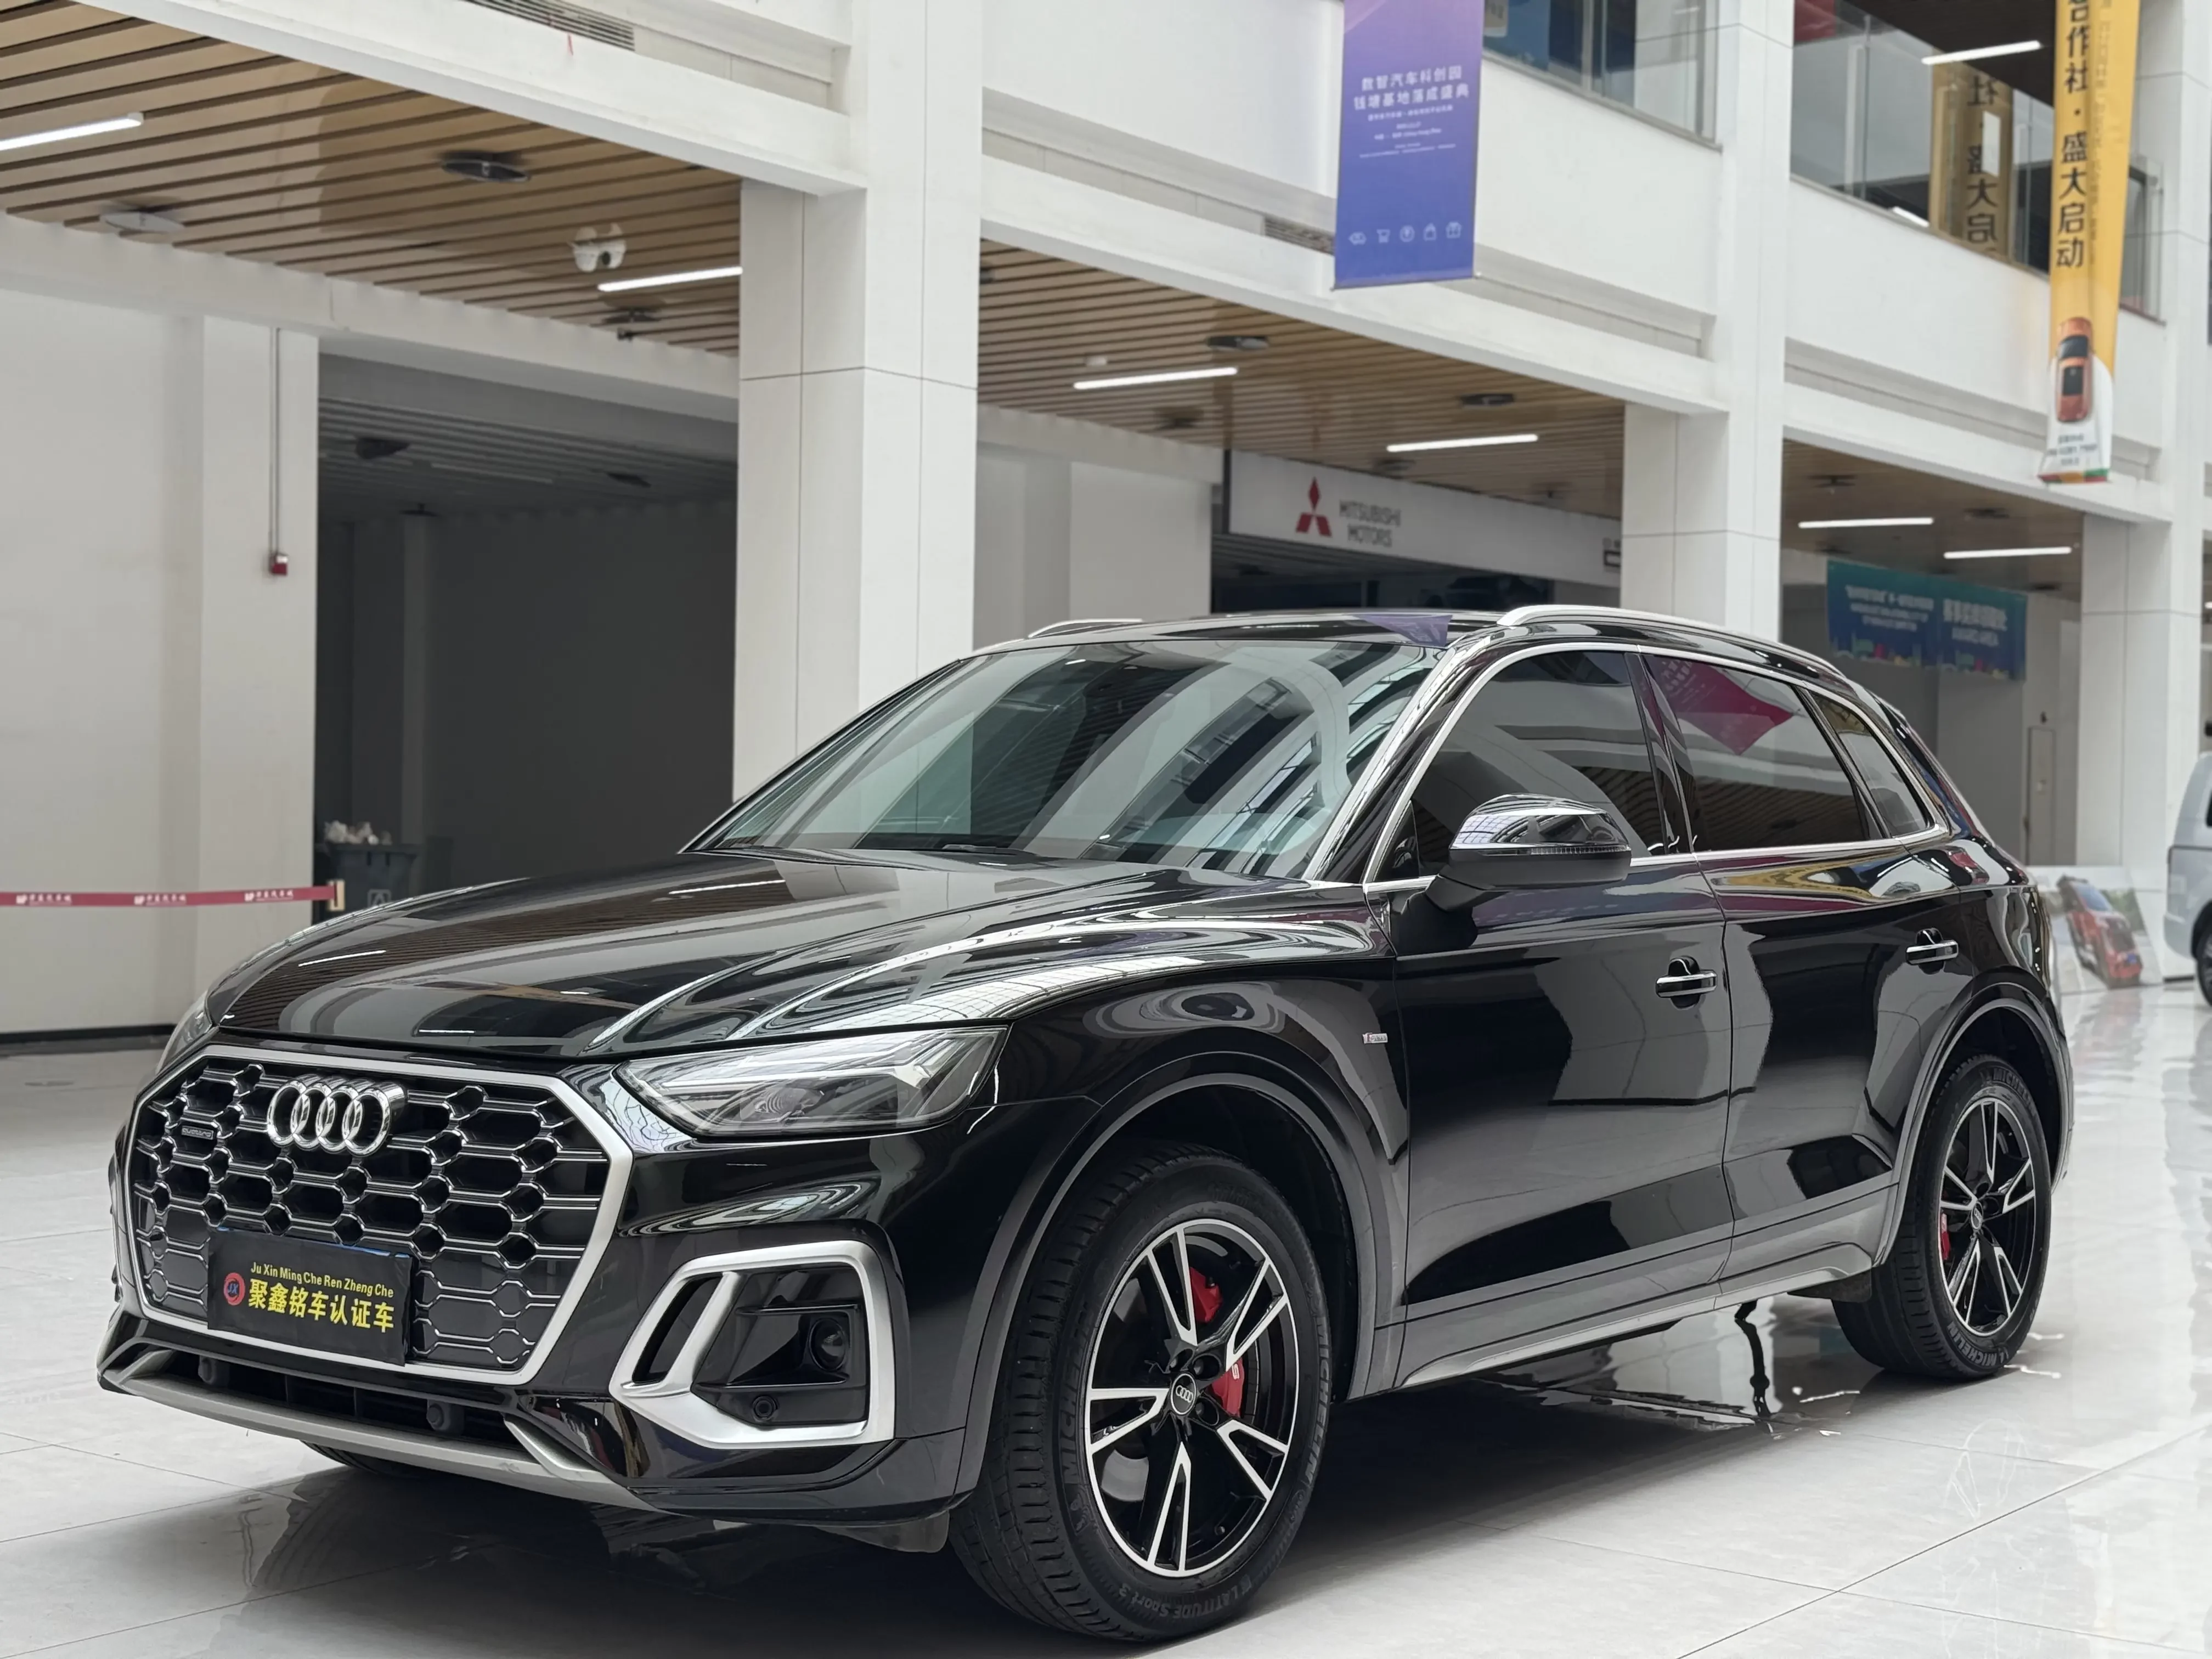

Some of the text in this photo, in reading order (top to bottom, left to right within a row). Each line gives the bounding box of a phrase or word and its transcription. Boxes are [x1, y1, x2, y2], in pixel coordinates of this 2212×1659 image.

[1339, 499, 1402, 527] MITSUBISHI
[1347, 523, 1393, 548] MOTORS
[251, 1262, 394, 1298] Ju Xin Ming Che Ren Zheng Che
[248, 1278, 395, 1333] 聚鑫铭车认证车
[1946, 1323, 1997, 1367] MICHELIN
[1305, 1316, 1331, 1488] MICHELIN
[1119, 1582, 1239, 1619] LATITUDE Sport 3
